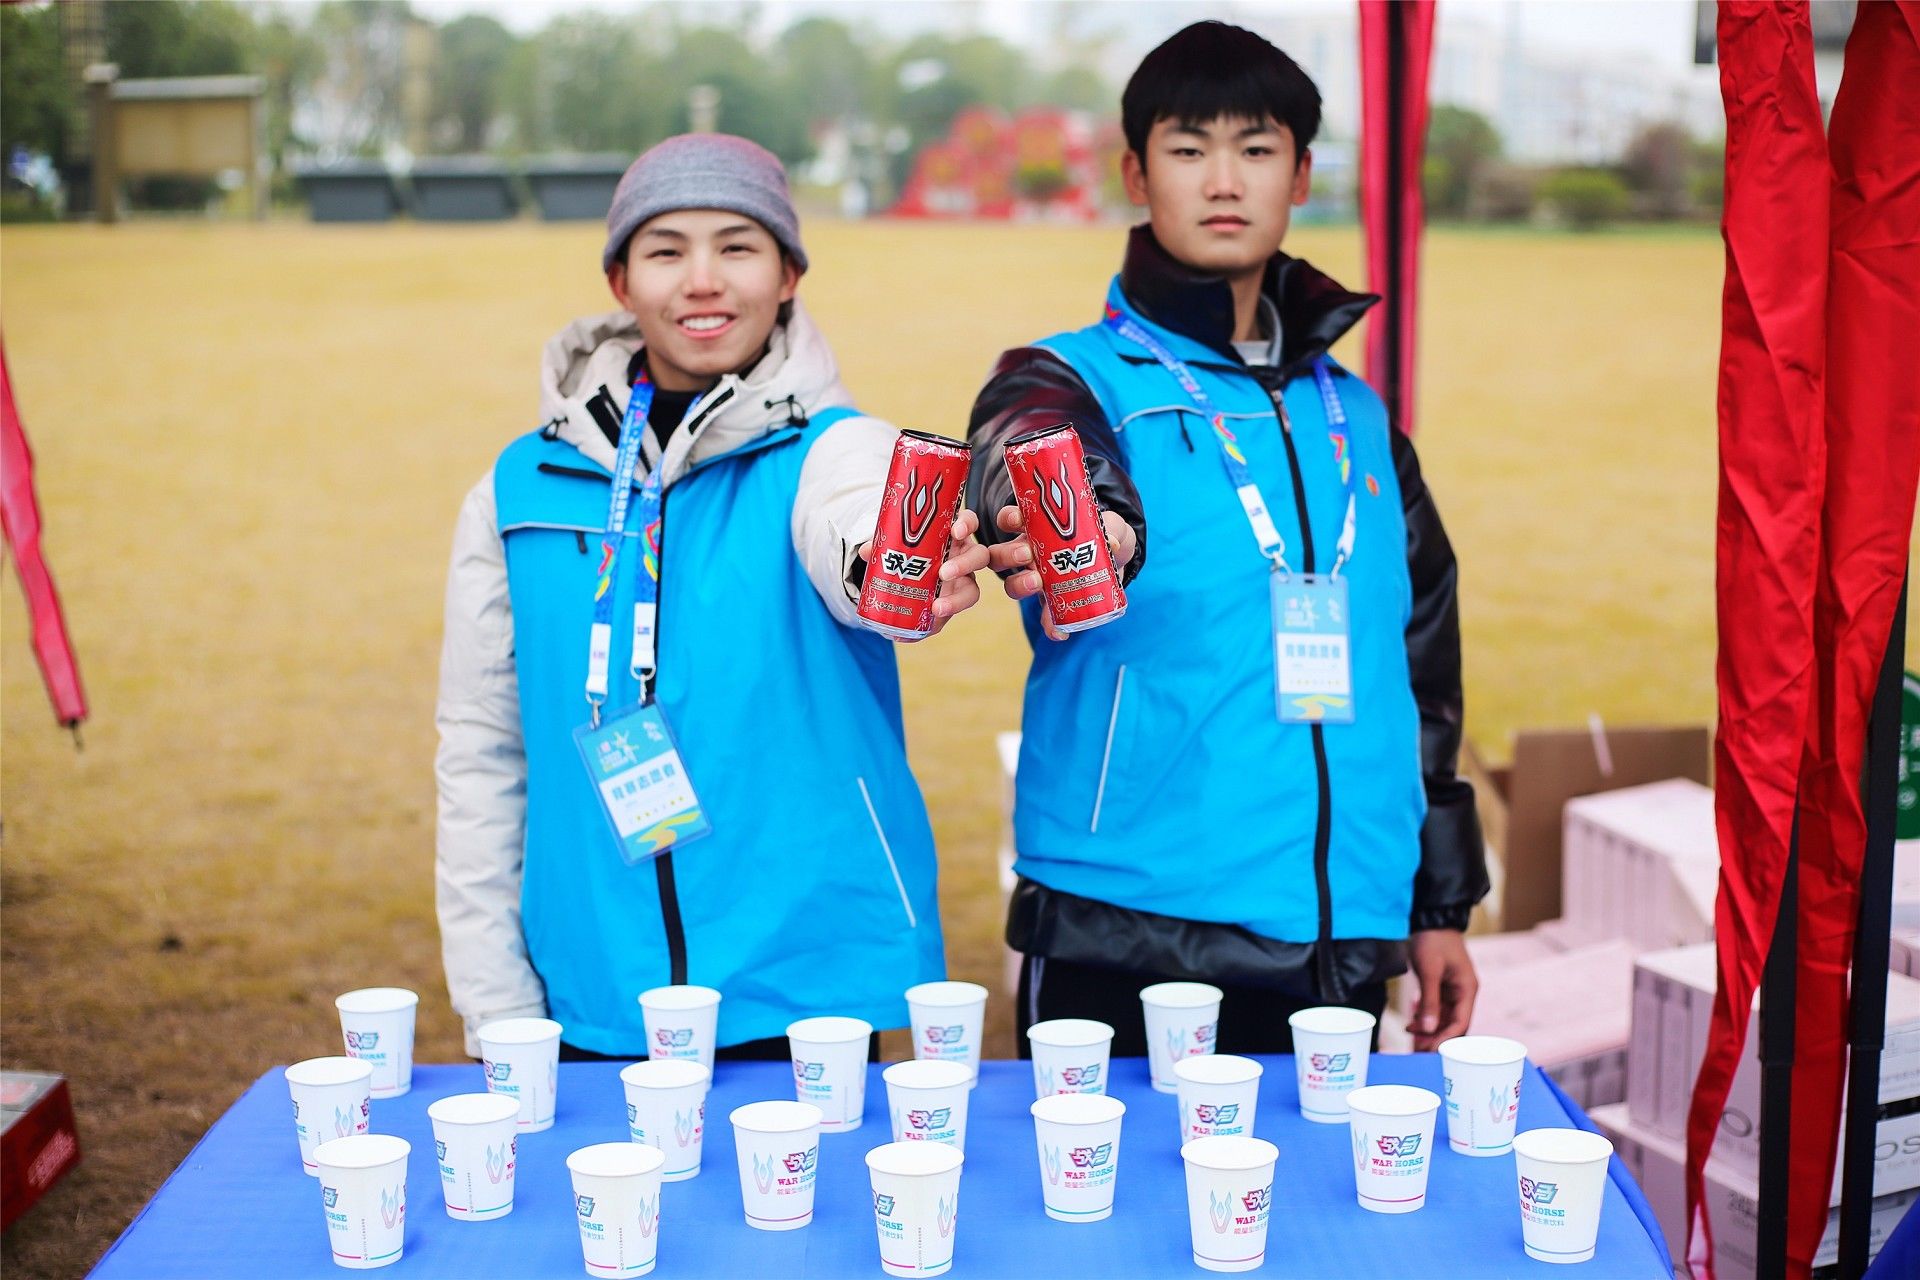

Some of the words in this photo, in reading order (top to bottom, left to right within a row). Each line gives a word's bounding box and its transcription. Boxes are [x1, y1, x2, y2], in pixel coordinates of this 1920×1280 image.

[1192, 1126, 1210, 1136] WAR
[1213, 1126, 1243, 1136] HORSE
[1371, 1157, 1393, 1167] WAR
[1395, 1156, 1425, 1167] HORSE
[1064, 1171, 1086, 1180] WAR
[1087, 1164, 1115, 1180] HORSE
[777, 1178, 798, 1187] WAR
[1532, 1205, 1565, 1218] HORSE
[1234, 1216, 1256, 1226] WAR
